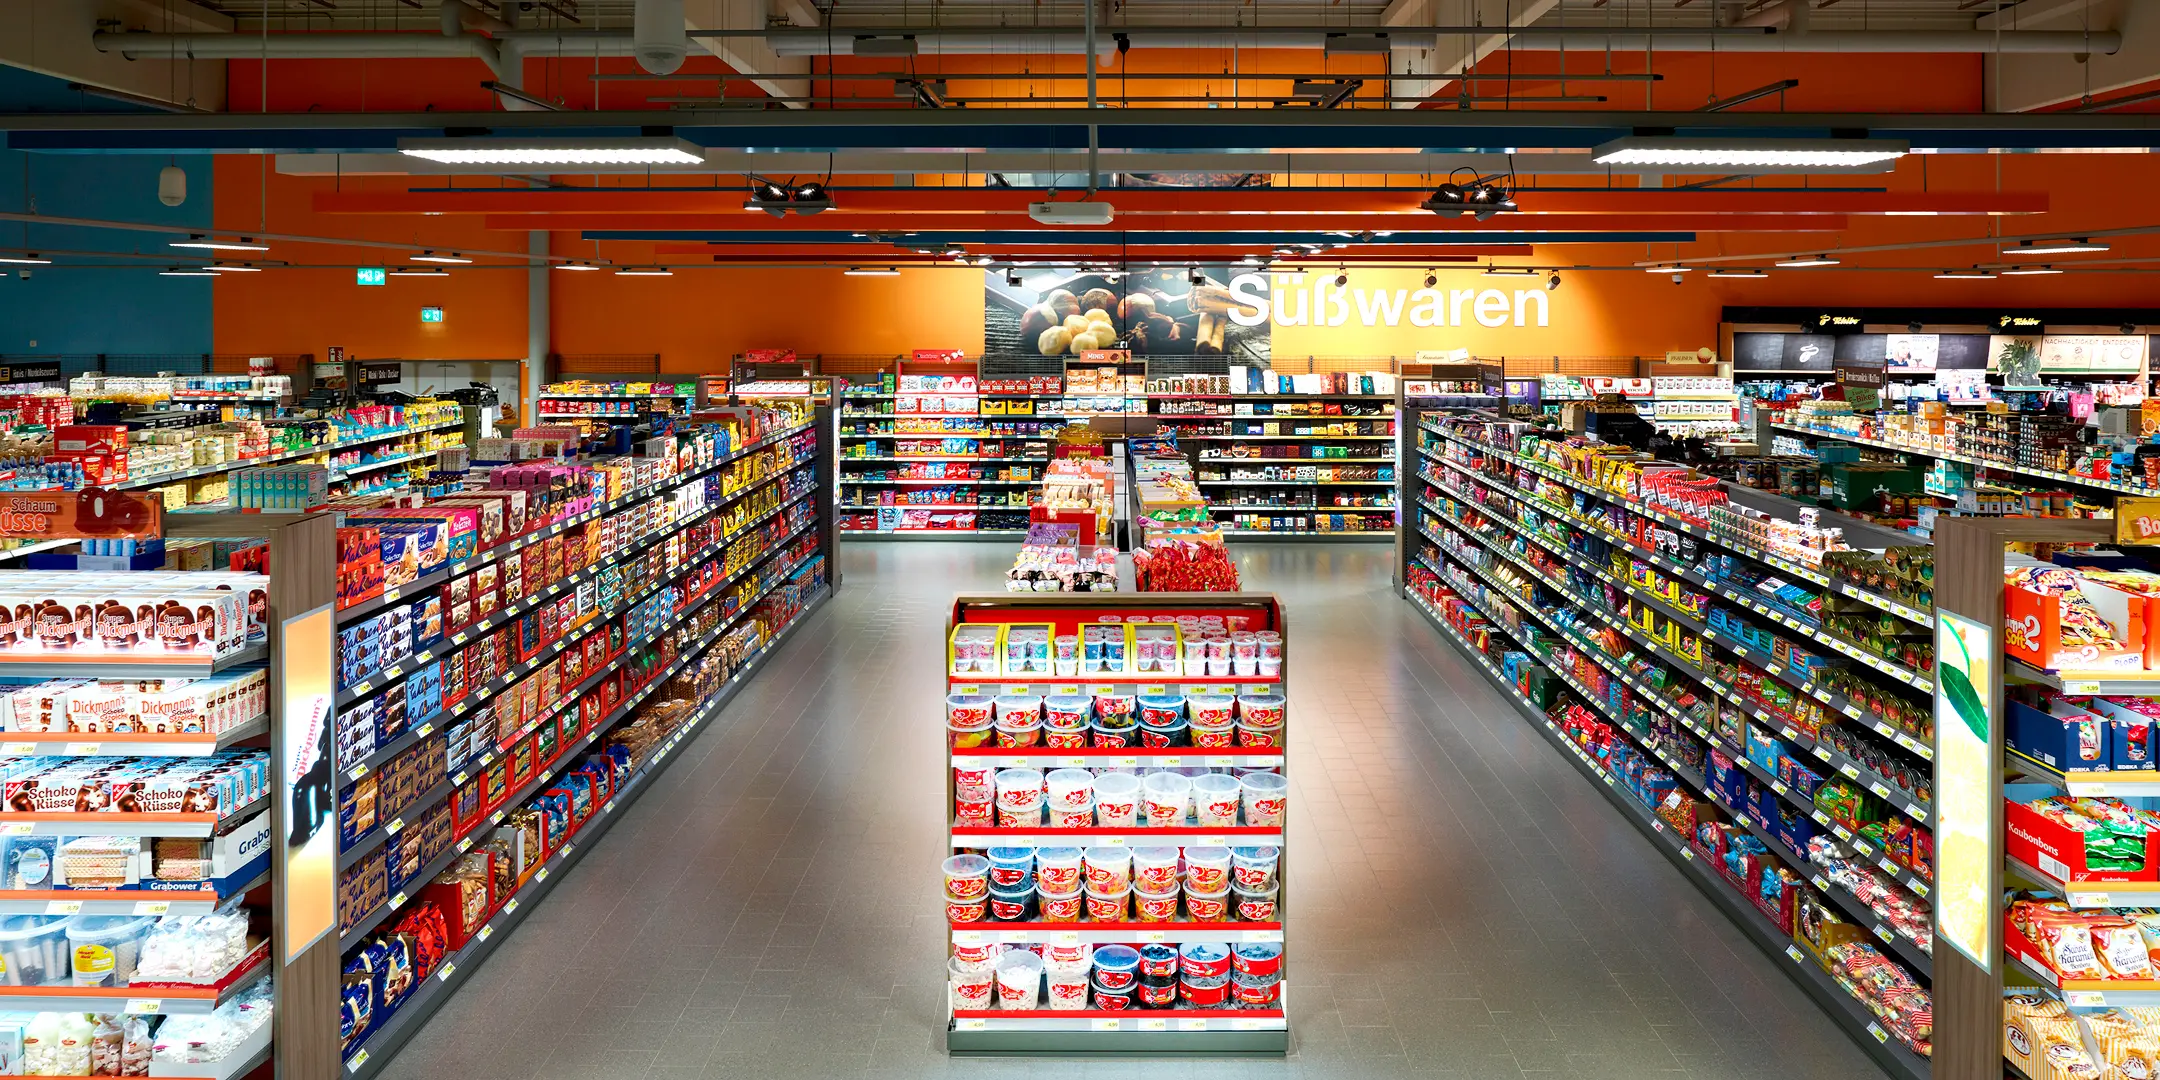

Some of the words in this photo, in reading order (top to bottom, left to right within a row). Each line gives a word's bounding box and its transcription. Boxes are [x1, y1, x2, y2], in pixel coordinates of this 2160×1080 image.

[1226, 273, 1549, 328] Süßwaren
[1833, 317, 1861, 325] Tchibo
[2014, 318, 2041, 326] Tchibo
[11, 497, 56, 512] Schaum
[0, 506, 47, 536] üsse
[419, 540, 433, 550] Selection
[384, 553, 401, 562] Selection
[42, 614, 64, 624] Super
[103, 614, 125, 624] Super
[164, 615, 186, 625] Super
[35, 616, 92, 638] Dickmann's
[96, 616, 153, 638] Dickmann's
[157, 617, 214, 639] Dickmann's
[2005, 629, 2027, 650] Soft
[73, 695, 127, 715] Dickmann's
[141, 696, 196, 716] Dickmann's
[296, 697, 323, 780] Dickmann's
[29, 785, 77, 800] Schoko
[135, 788, 183, 801] Schoko
[36, 799, 75, 810] Küsse
[142, 801, 181, 812] Küsse
[238, 828, 271, 855] Grabo
[2008, 821, 2059, 857] Kaubonbons
[151, 882, 197, 891] Grabower
[2059, 951, 2095, 965] Karamell
